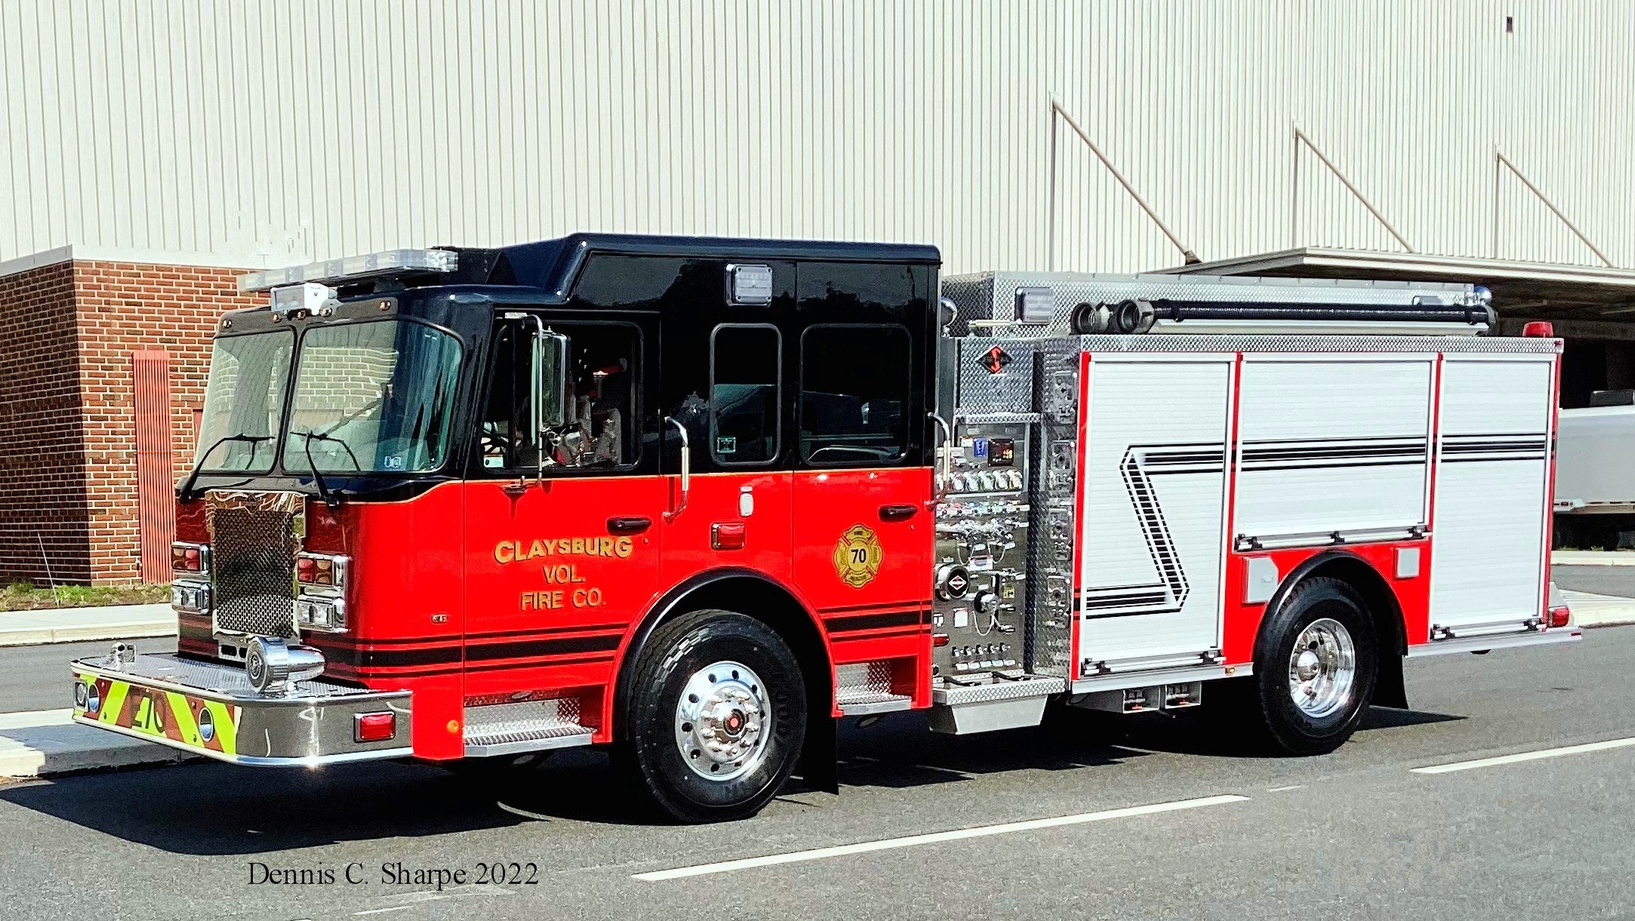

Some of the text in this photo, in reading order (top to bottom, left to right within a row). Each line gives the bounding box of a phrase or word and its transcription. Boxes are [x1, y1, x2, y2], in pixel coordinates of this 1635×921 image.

[494, 536, 633, 564] CLAYSBURG
[851, 548, 867, 564] 70
[543, 564, 586, 584] VOL.
[520, 587, 606, 611] FIRE CO.
